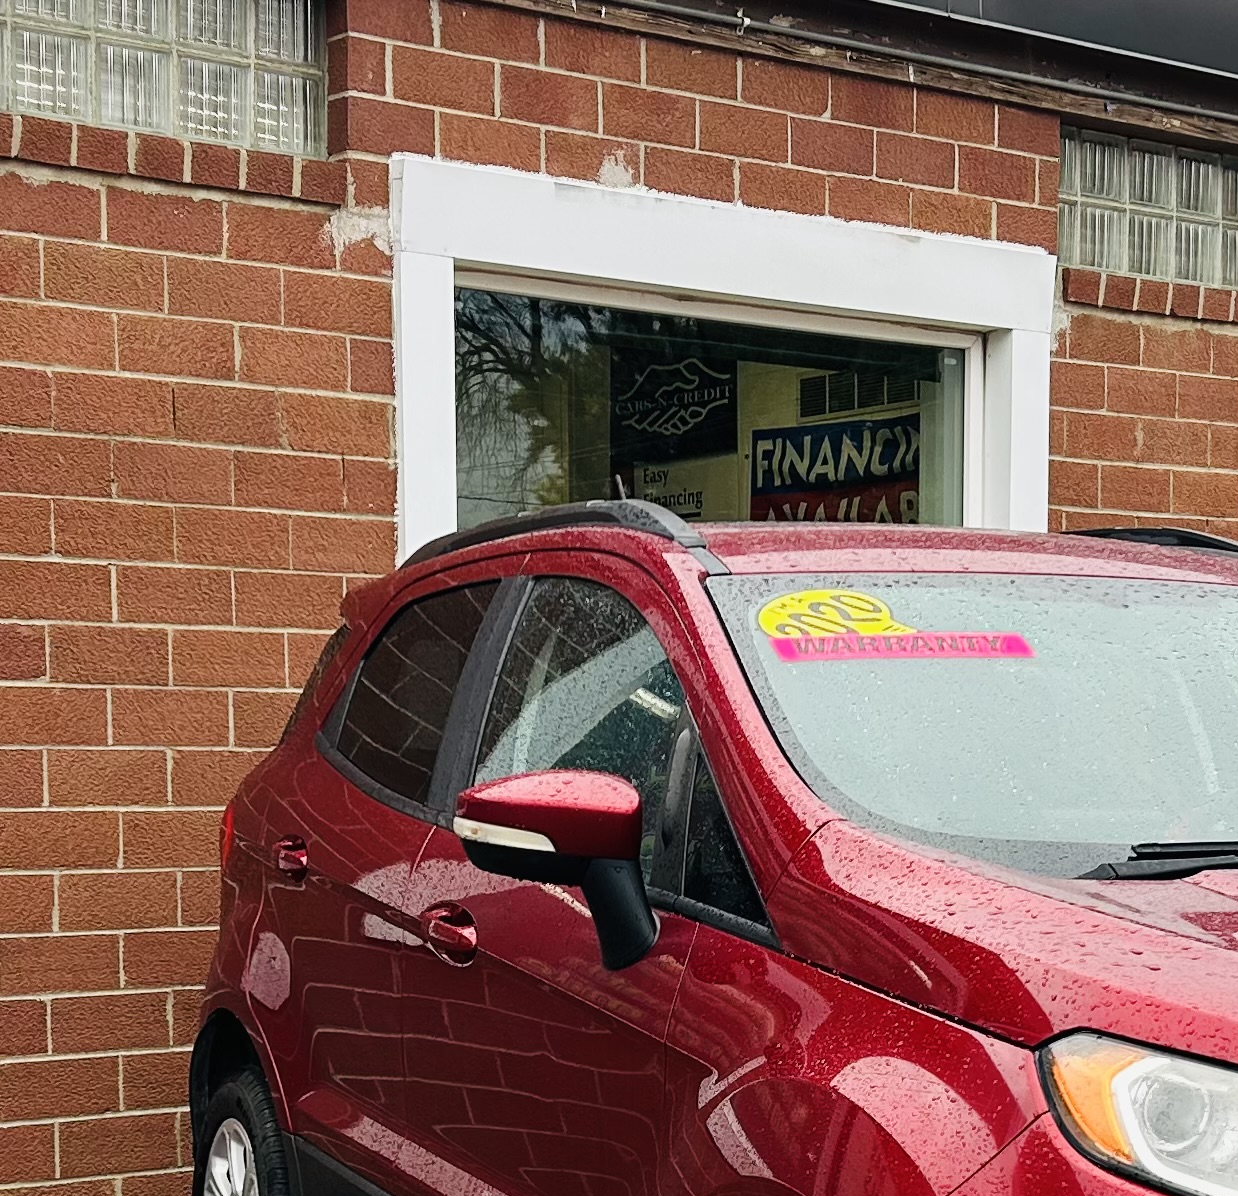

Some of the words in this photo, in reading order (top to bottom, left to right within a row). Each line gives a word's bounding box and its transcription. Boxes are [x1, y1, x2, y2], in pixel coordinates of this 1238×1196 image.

[615, 384, 733, 415] CARS-N-CREDIT
[643, 467, 670, 488] Easy
[775, 594, 883, 636] 2020
[794, 635, 1004, 653] WARRANTY
